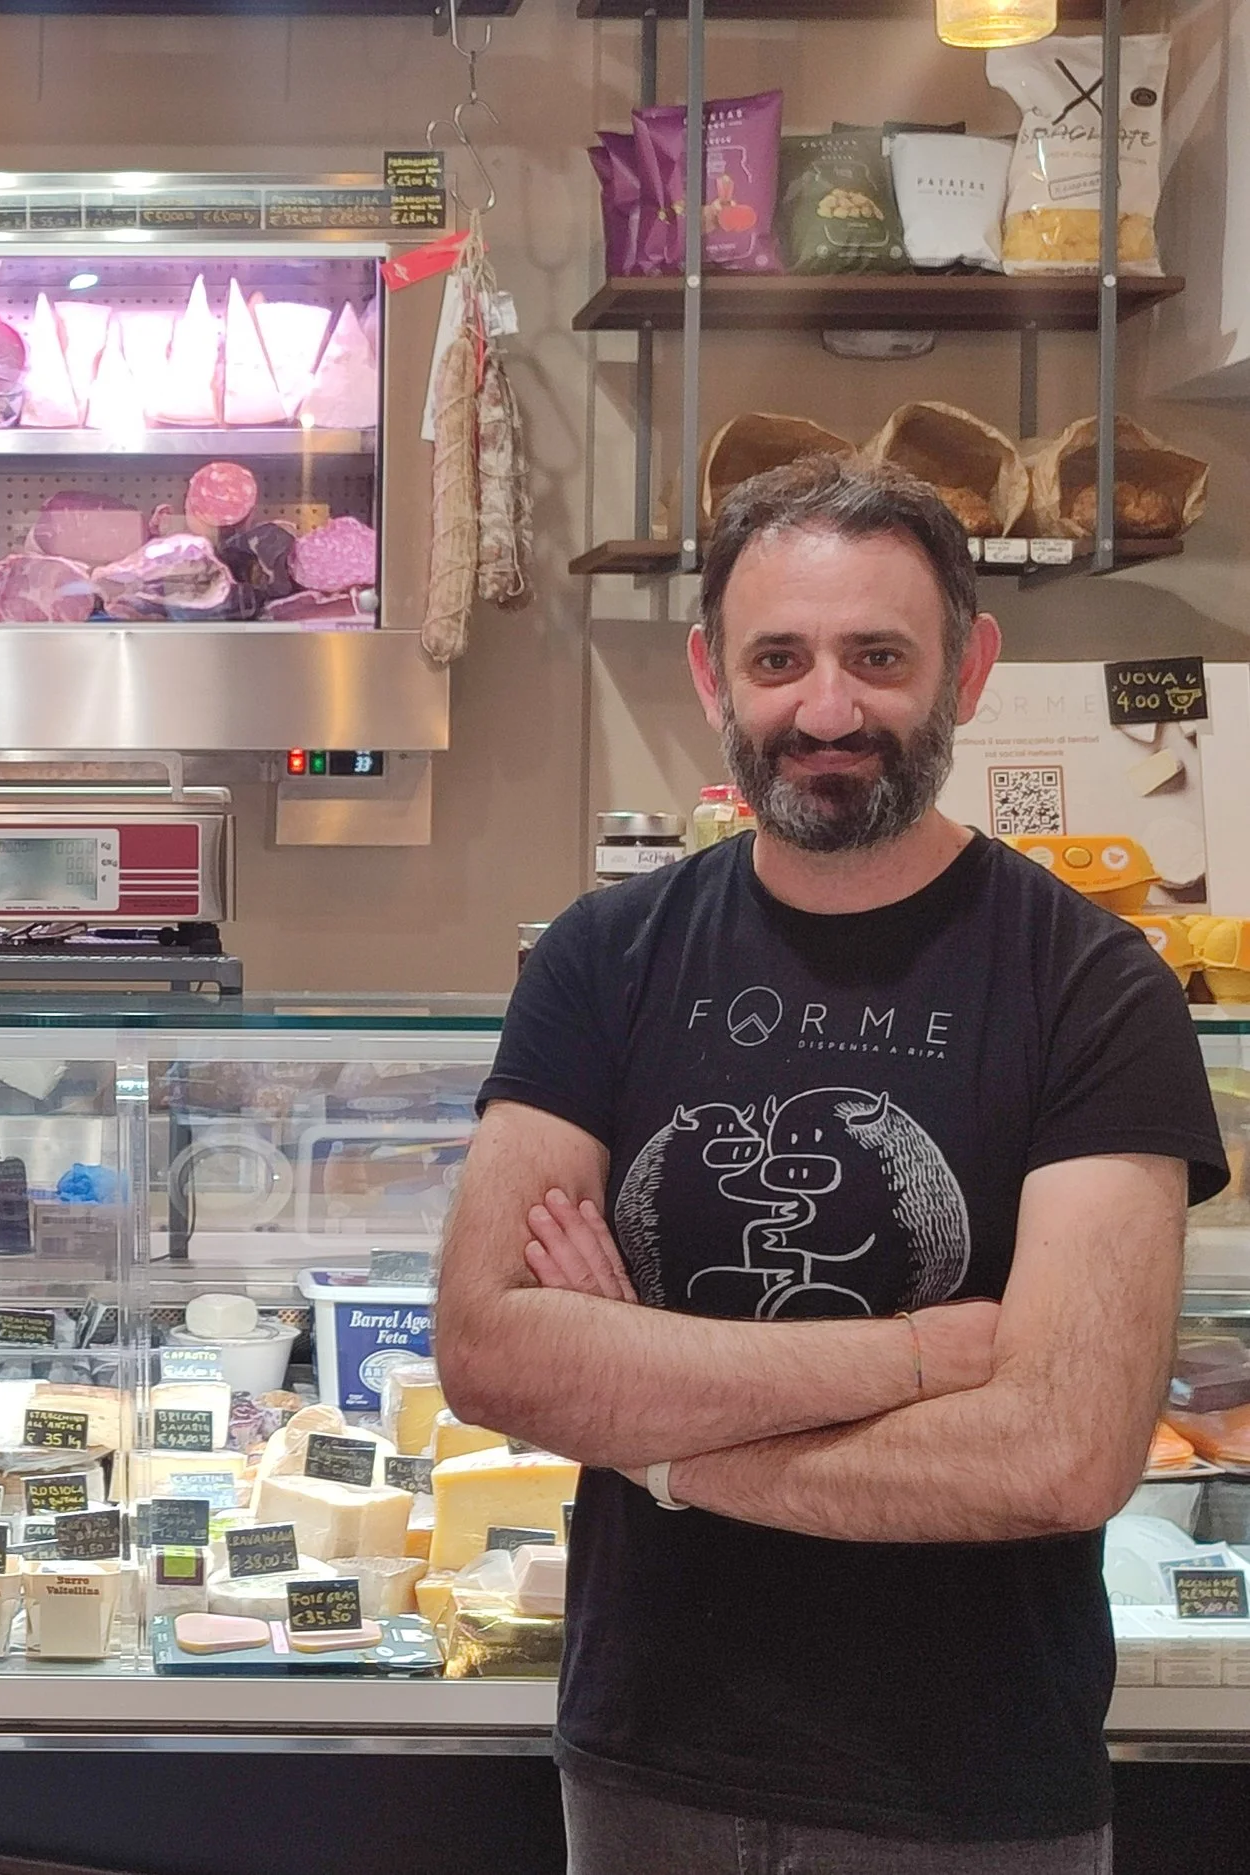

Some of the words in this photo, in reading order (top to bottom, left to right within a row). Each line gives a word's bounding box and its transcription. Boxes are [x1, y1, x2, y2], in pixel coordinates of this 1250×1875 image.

[1118, 671, 1178, 686] UOVA
[688, 986, 953, 1046] FORME
[797, 1040, 880, 1052] DISPENSA
[890, 1046, 898, 1054] A
[907, 1047, 946, 1060] RIPA
[350, 1310, 400, 1328] Barrel
[376, 1329, 409, 1345] Feta
[157, 1411, 210, 1422] BRILLAT
[41, 1432, 63, 1446] 35
[29, 1485, 84, 1496] ROBIOLA
[56, 1575, 90, 1585] Burro
[45, 1585, 100, 1596] Valtellina
[290, 1591, 325, 1606] FOIE
